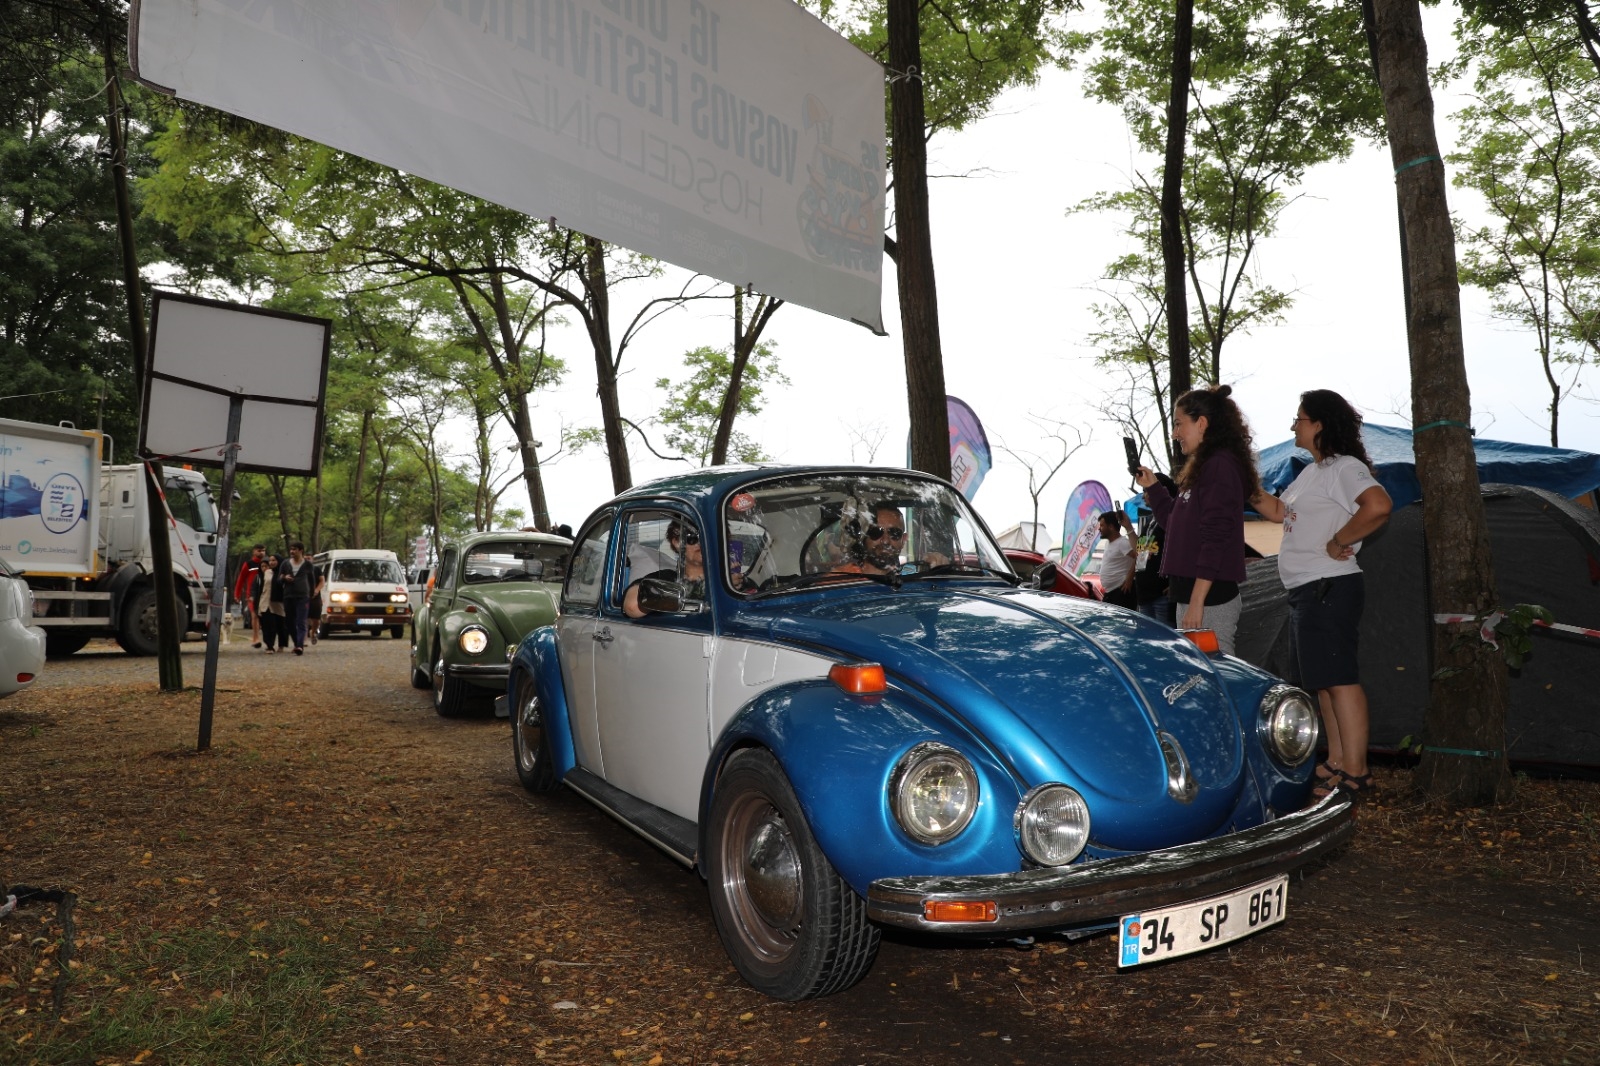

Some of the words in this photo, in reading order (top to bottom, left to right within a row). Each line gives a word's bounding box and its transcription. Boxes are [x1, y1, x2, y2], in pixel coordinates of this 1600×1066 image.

[1141, 916, 1175, 956] 34
[1199, 904, 1229, 943] SP
[1248, 884, 1284, 927] 861
[1125, 944, 1138, 955] TR
